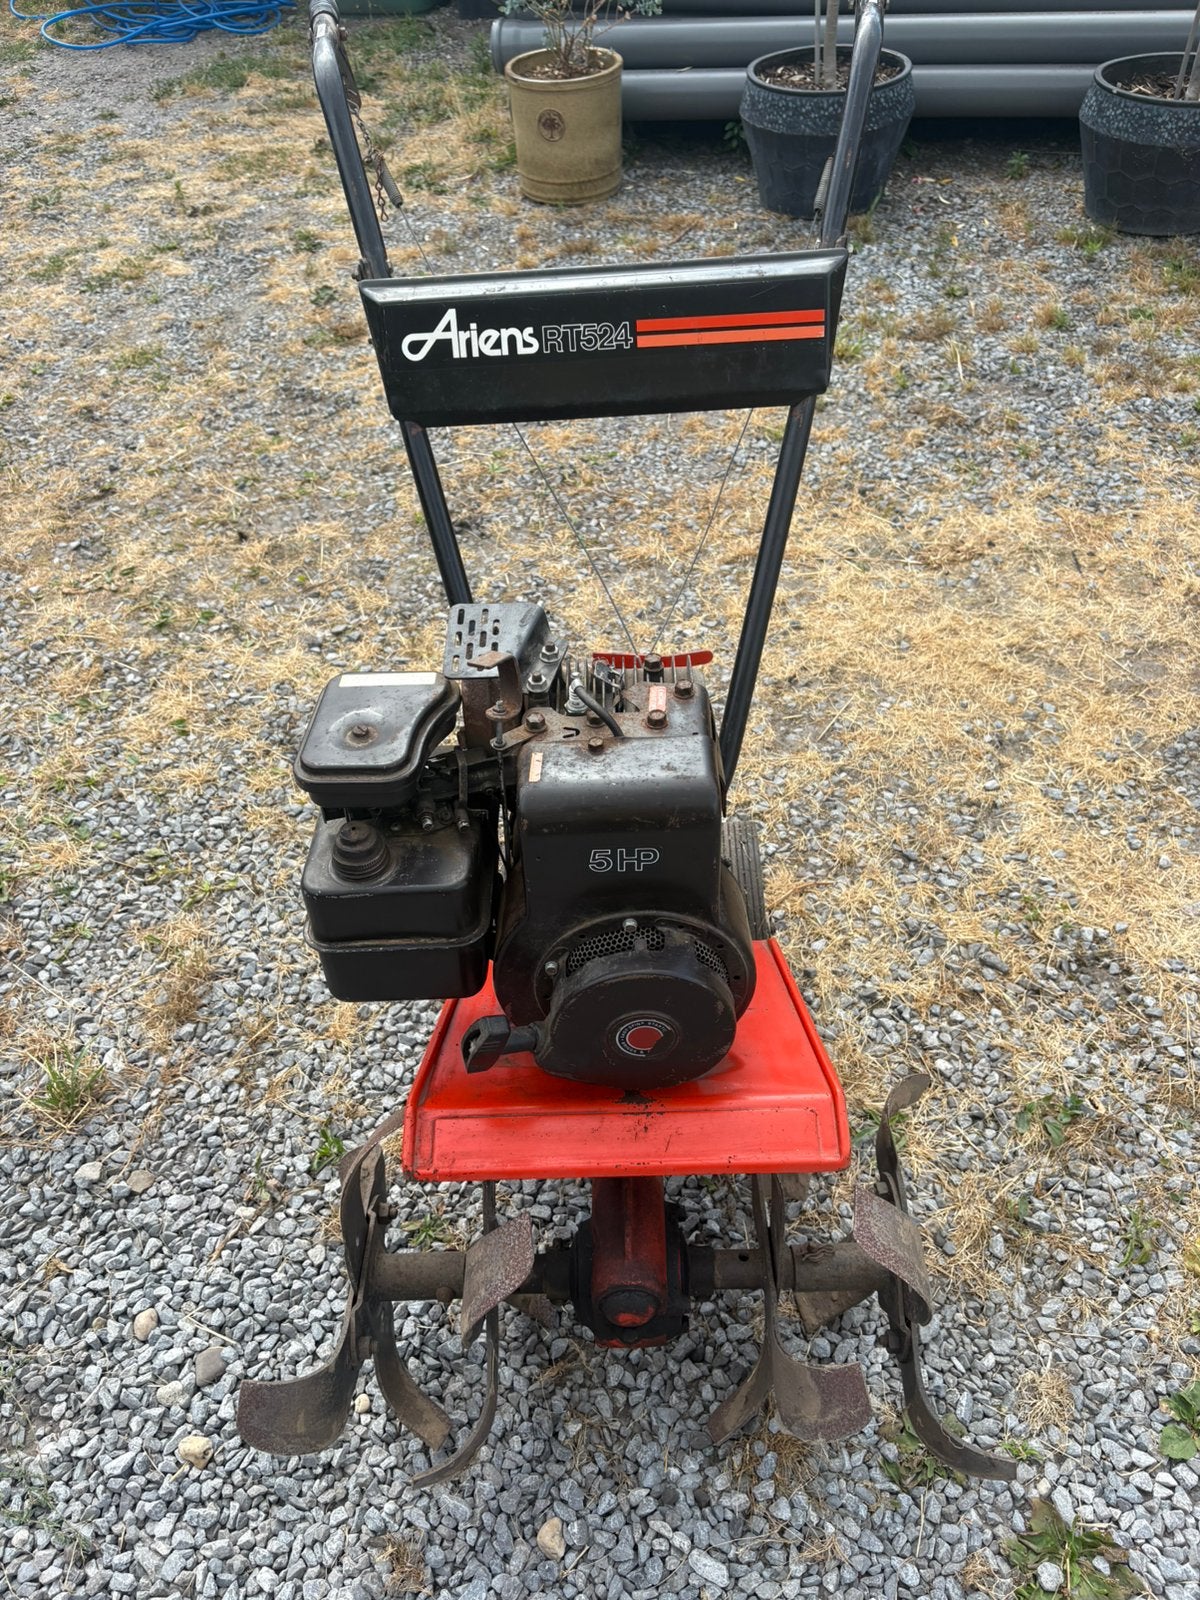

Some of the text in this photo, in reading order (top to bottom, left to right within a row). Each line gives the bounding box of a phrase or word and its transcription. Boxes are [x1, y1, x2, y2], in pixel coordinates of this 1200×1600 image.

[401, 308, 634, 362] Ariens RT524
[588, 847, 660, 873] 5 HP
